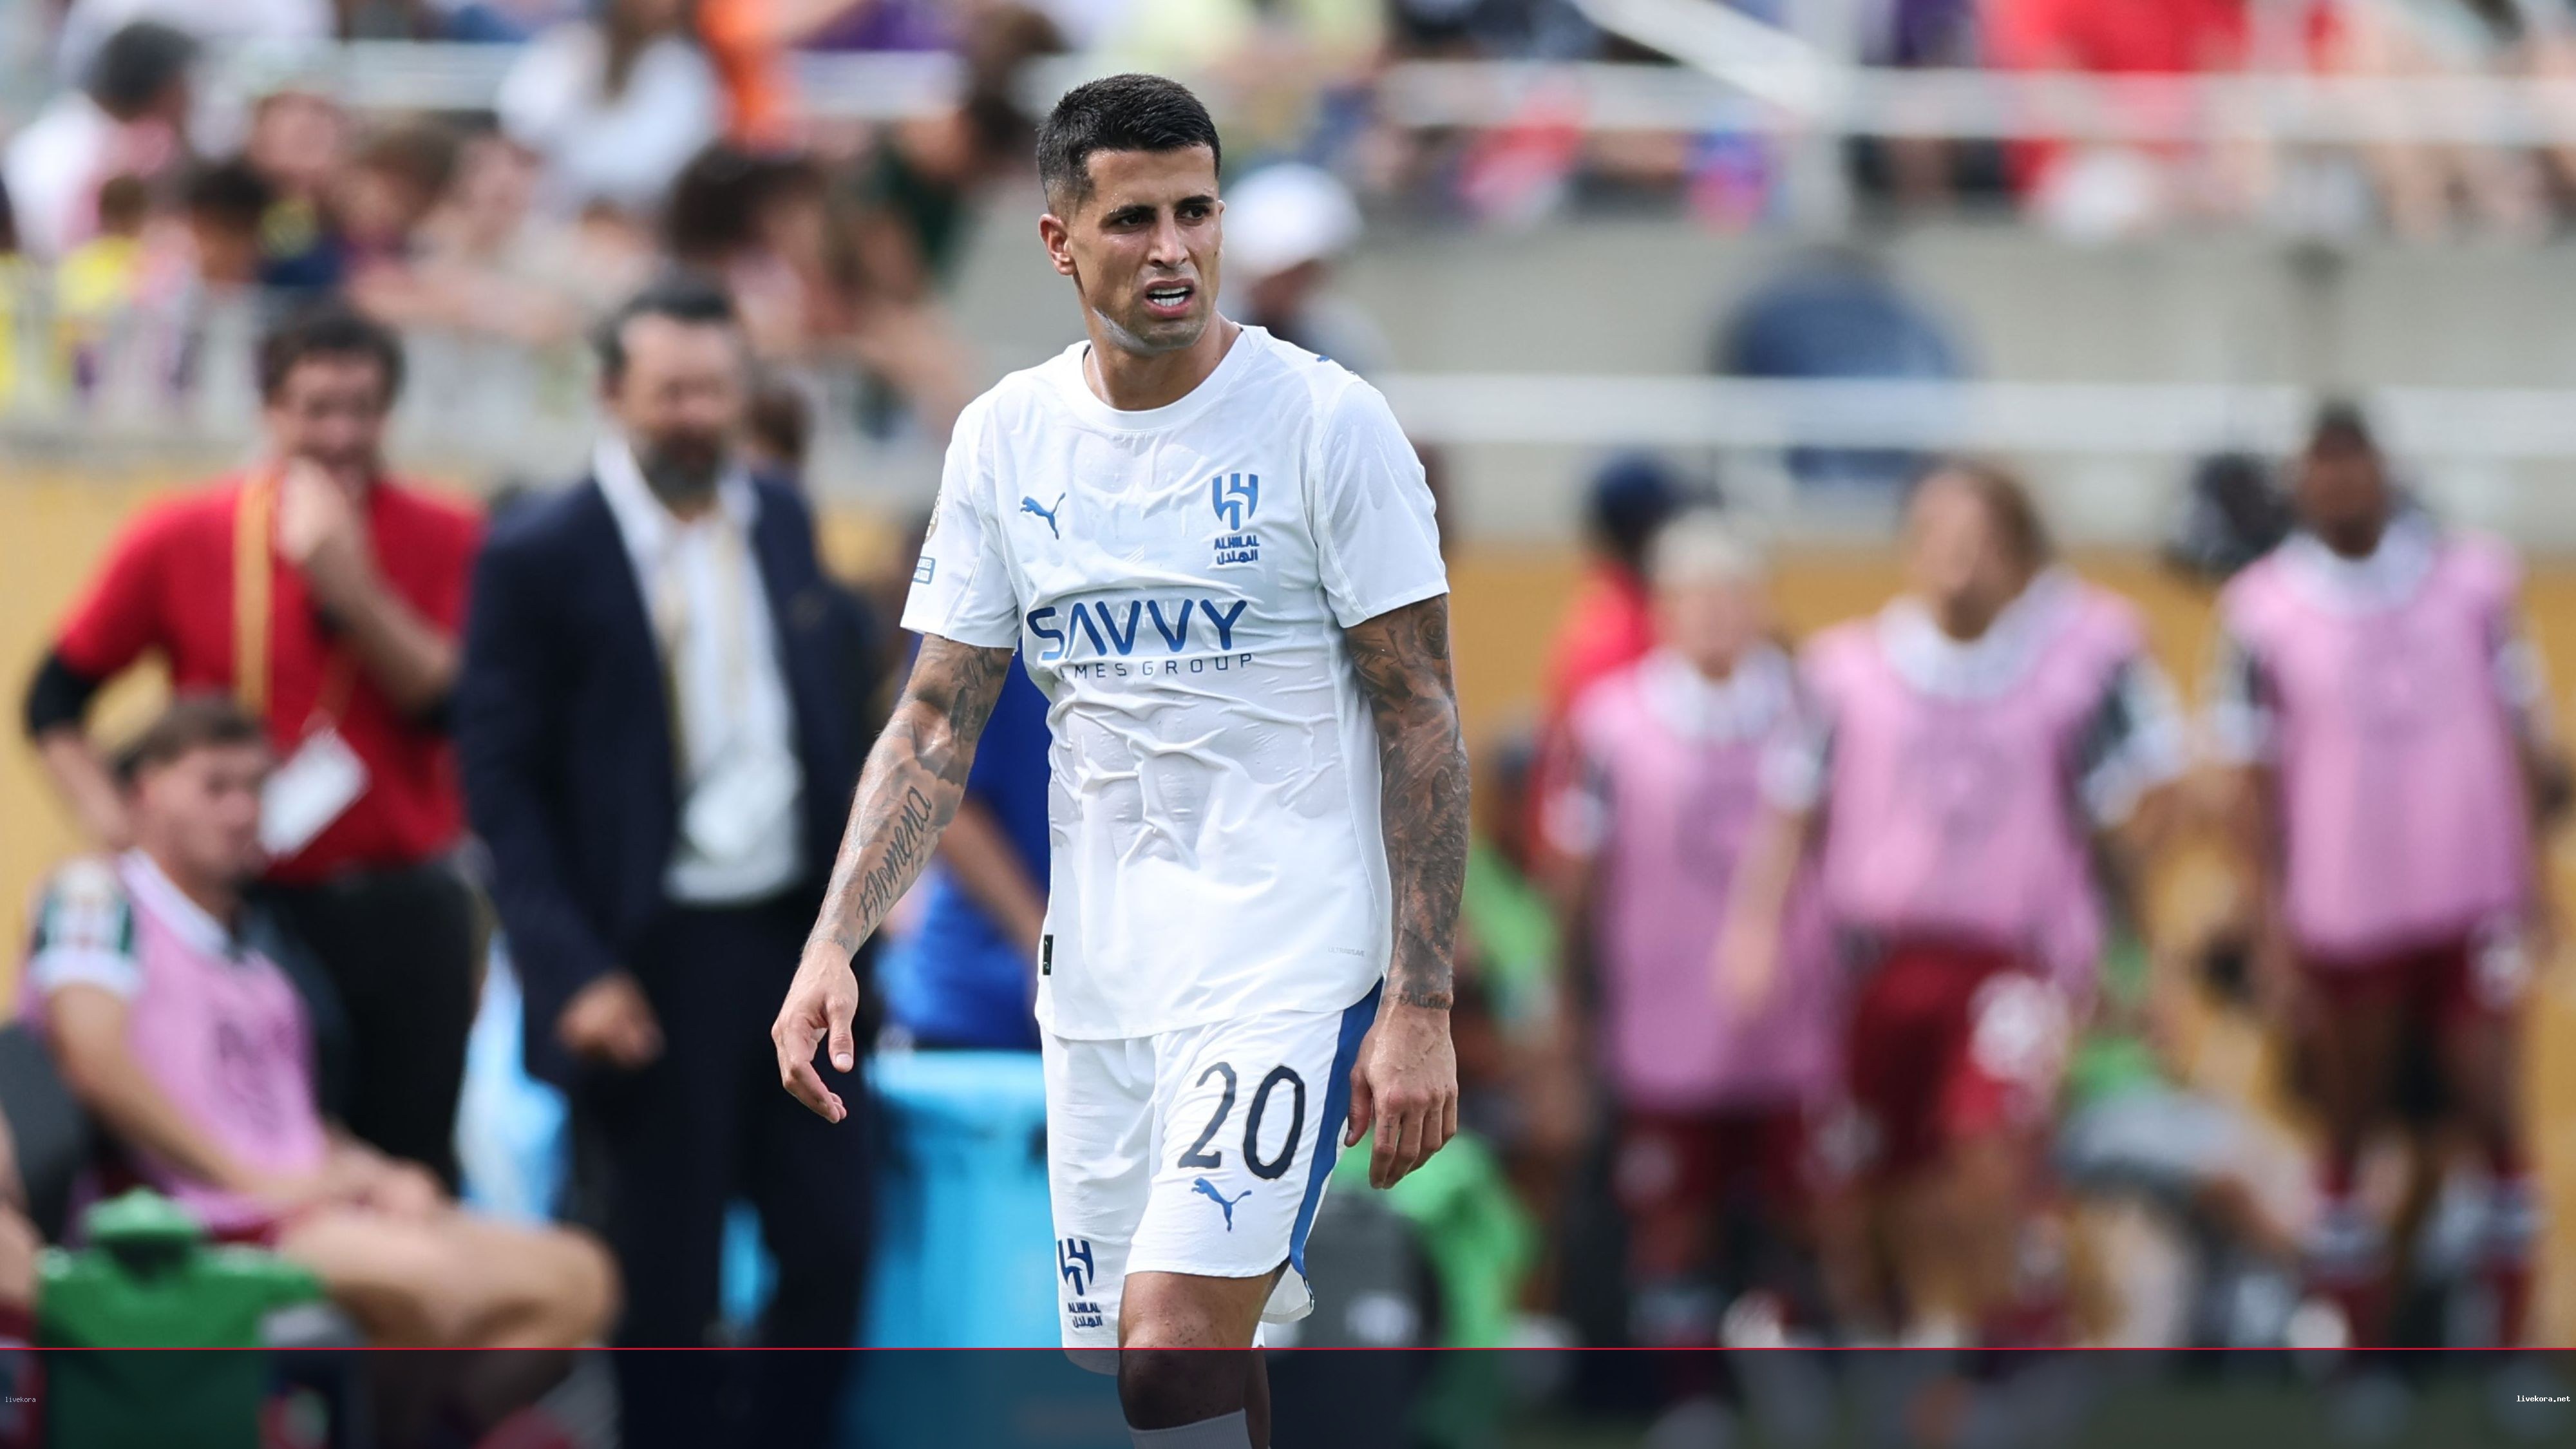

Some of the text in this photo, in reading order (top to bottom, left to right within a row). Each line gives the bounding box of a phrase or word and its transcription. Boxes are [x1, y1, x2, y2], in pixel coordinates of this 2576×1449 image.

[1027, 599, 1247, 661] SAVVY
[1142, 654, 1252, 676] GROUP
[1177, 1061, 1307, 1181] 20
